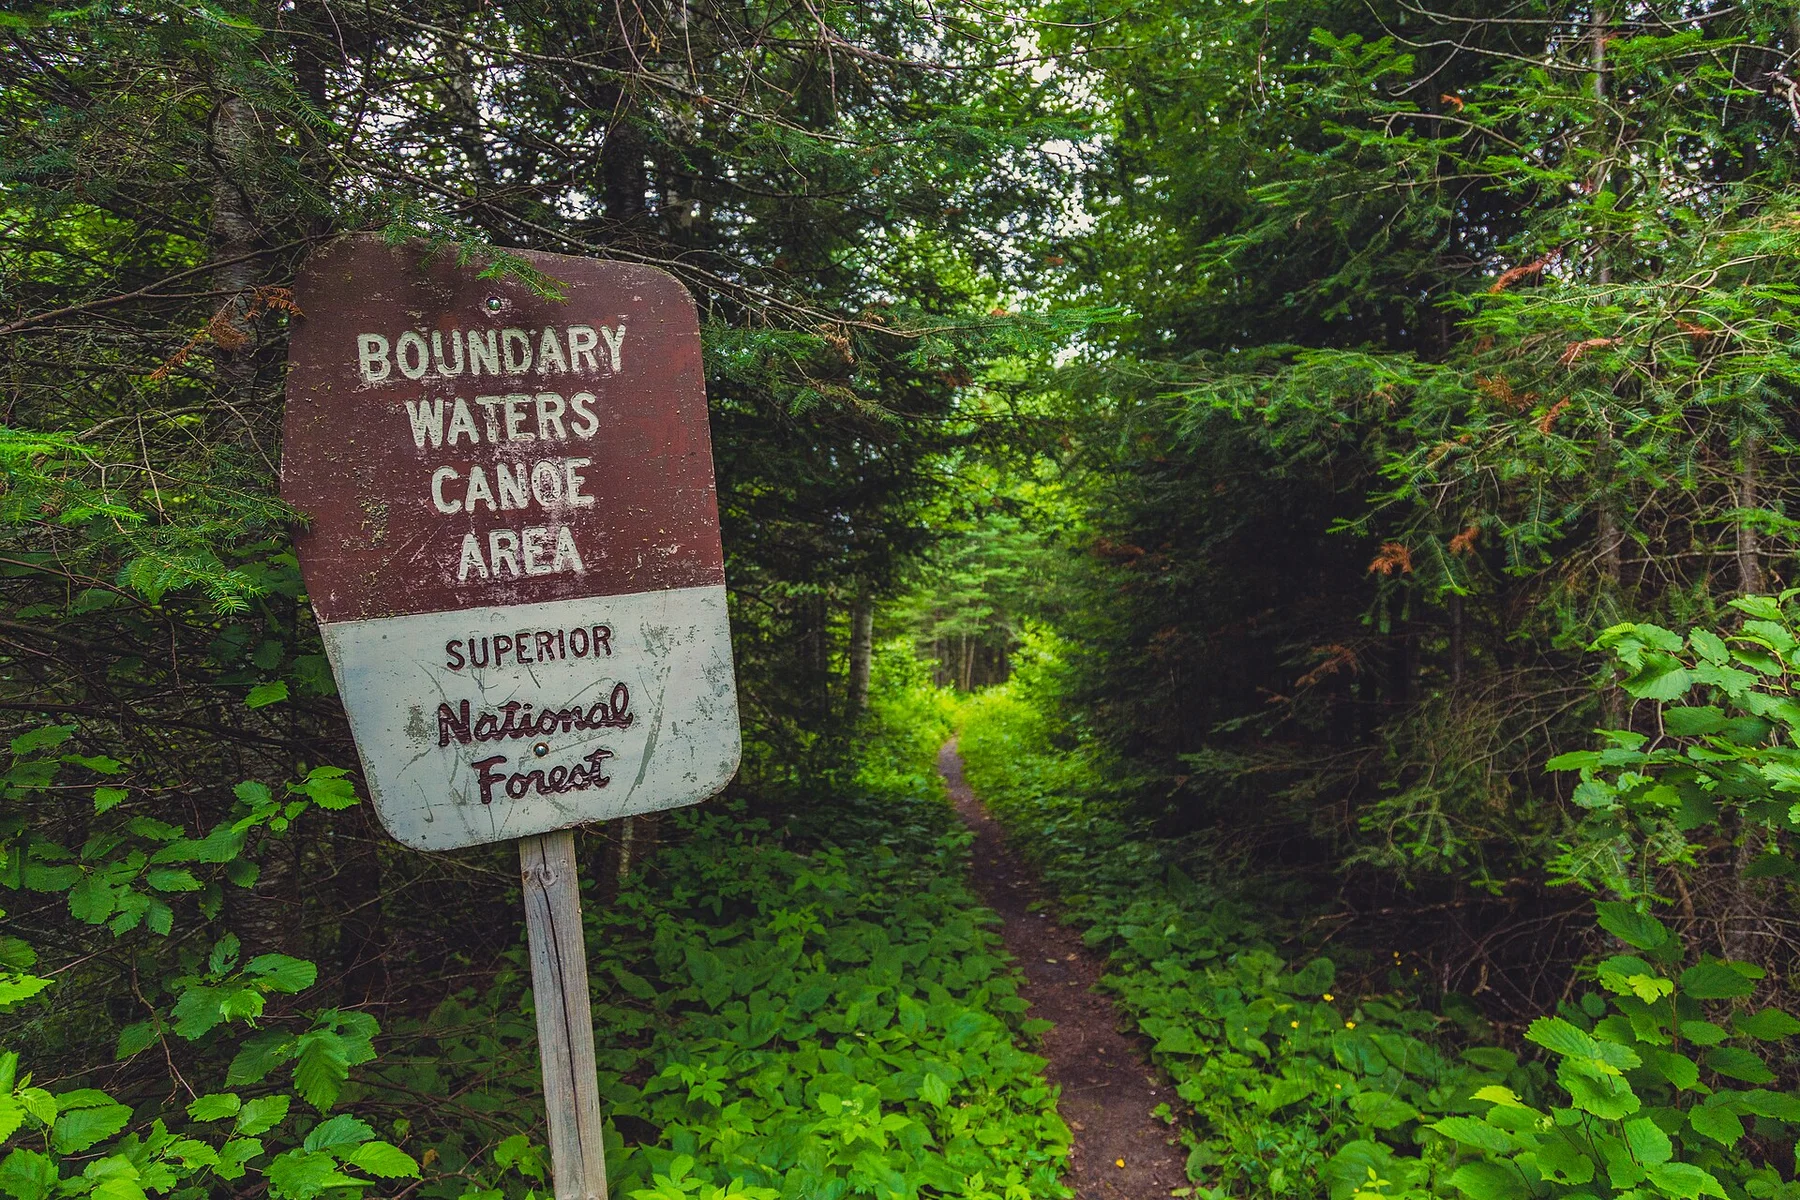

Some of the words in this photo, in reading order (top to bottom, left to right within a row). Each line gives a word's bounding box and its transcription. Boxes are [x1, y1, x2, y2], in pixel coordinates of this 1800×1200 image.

[357, 324, 626, 383] BOUNDARY
[406, 392, 599, 448] WATERS
[432, 457, 595, 514] CANOE
[459, 526, 584, 581] AREA
[445, 625, 612, 671] SUPERIOR
[438, 682, 634, 748] National
[471, 749, 614, 805] Forest
